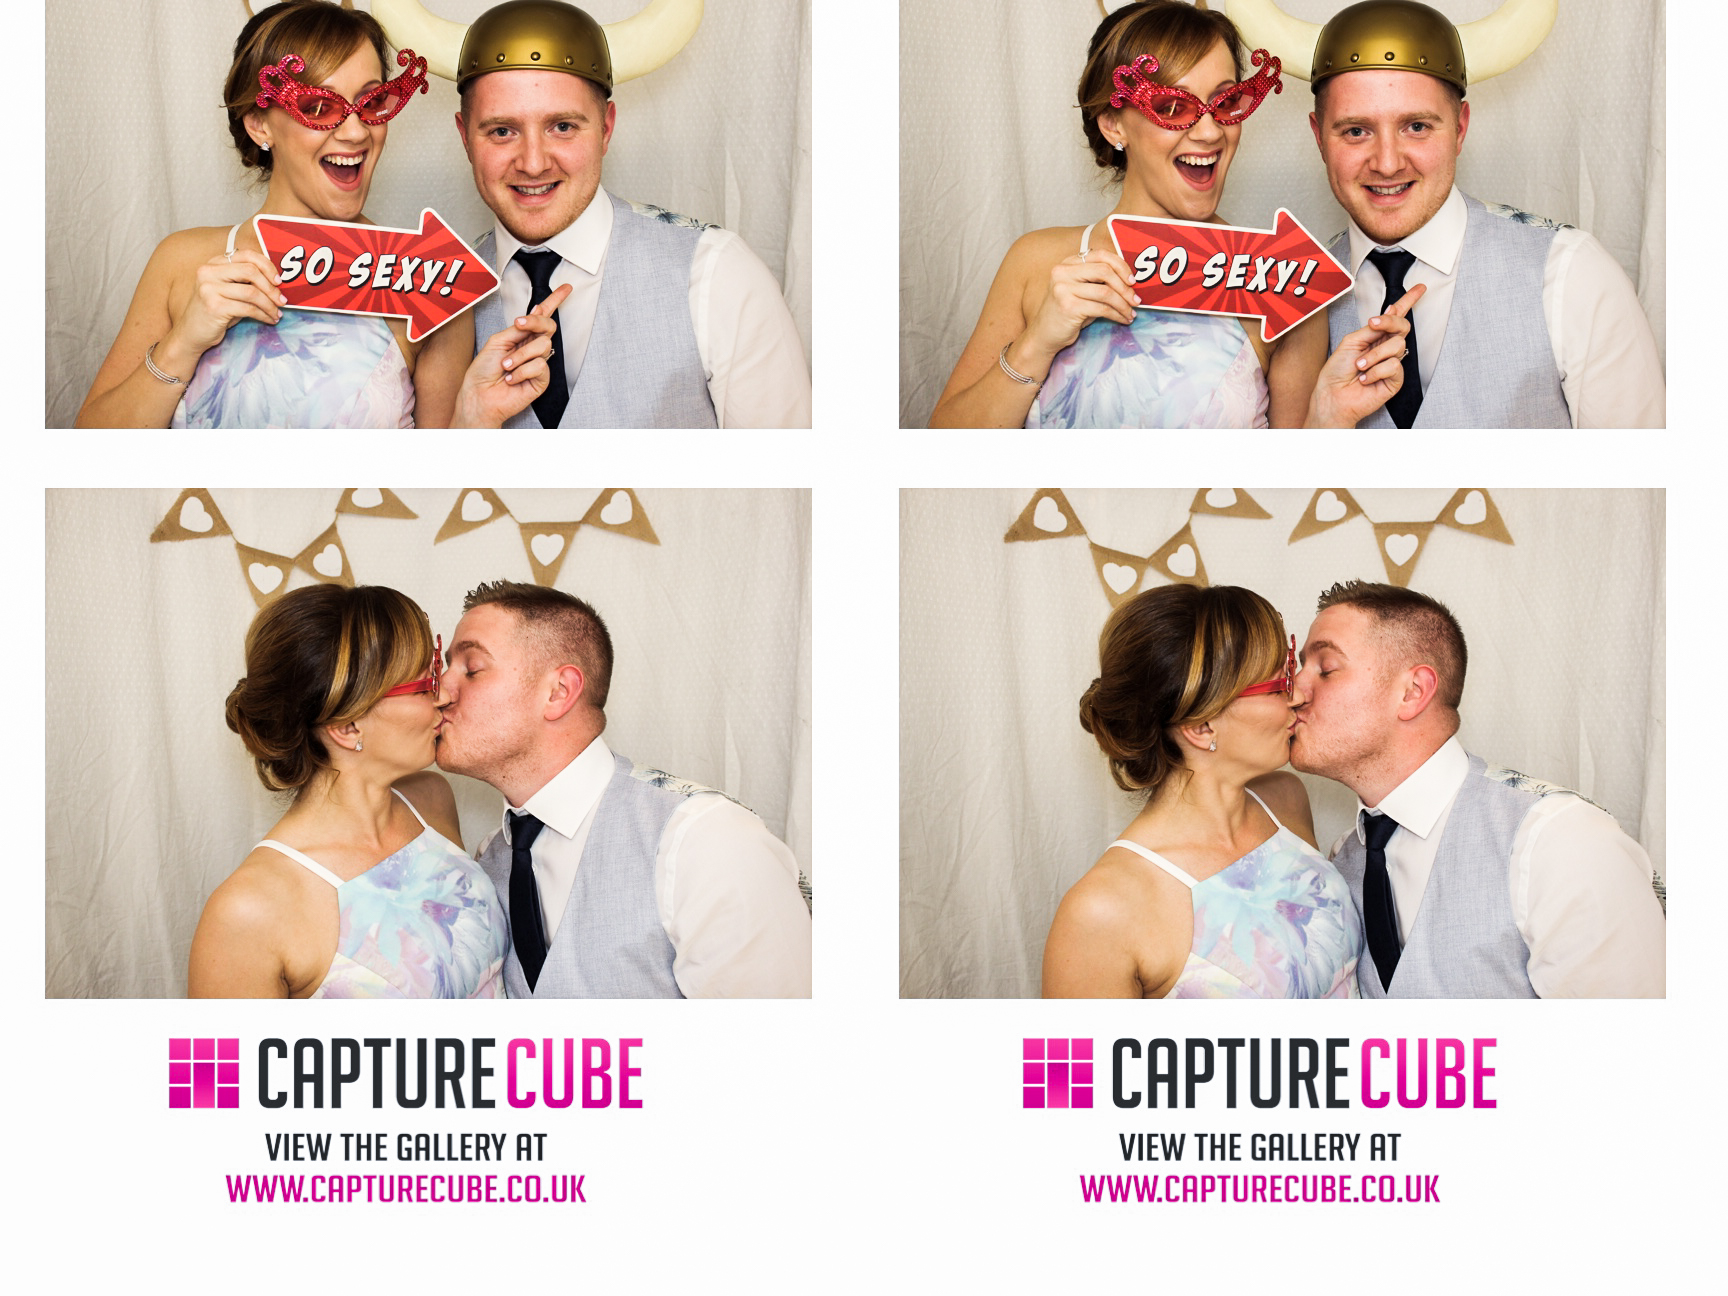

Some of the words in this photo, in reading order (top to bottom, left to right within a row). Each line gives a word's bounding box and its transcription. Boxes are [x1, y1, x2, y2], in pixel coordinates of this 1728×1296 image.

[280, 245, 334, 285] SO
[348, 252, 465, 297] SEXY!
[1134, 245, 1188, 285] SO
[1202, 252, 1319, 297] SEXY!
